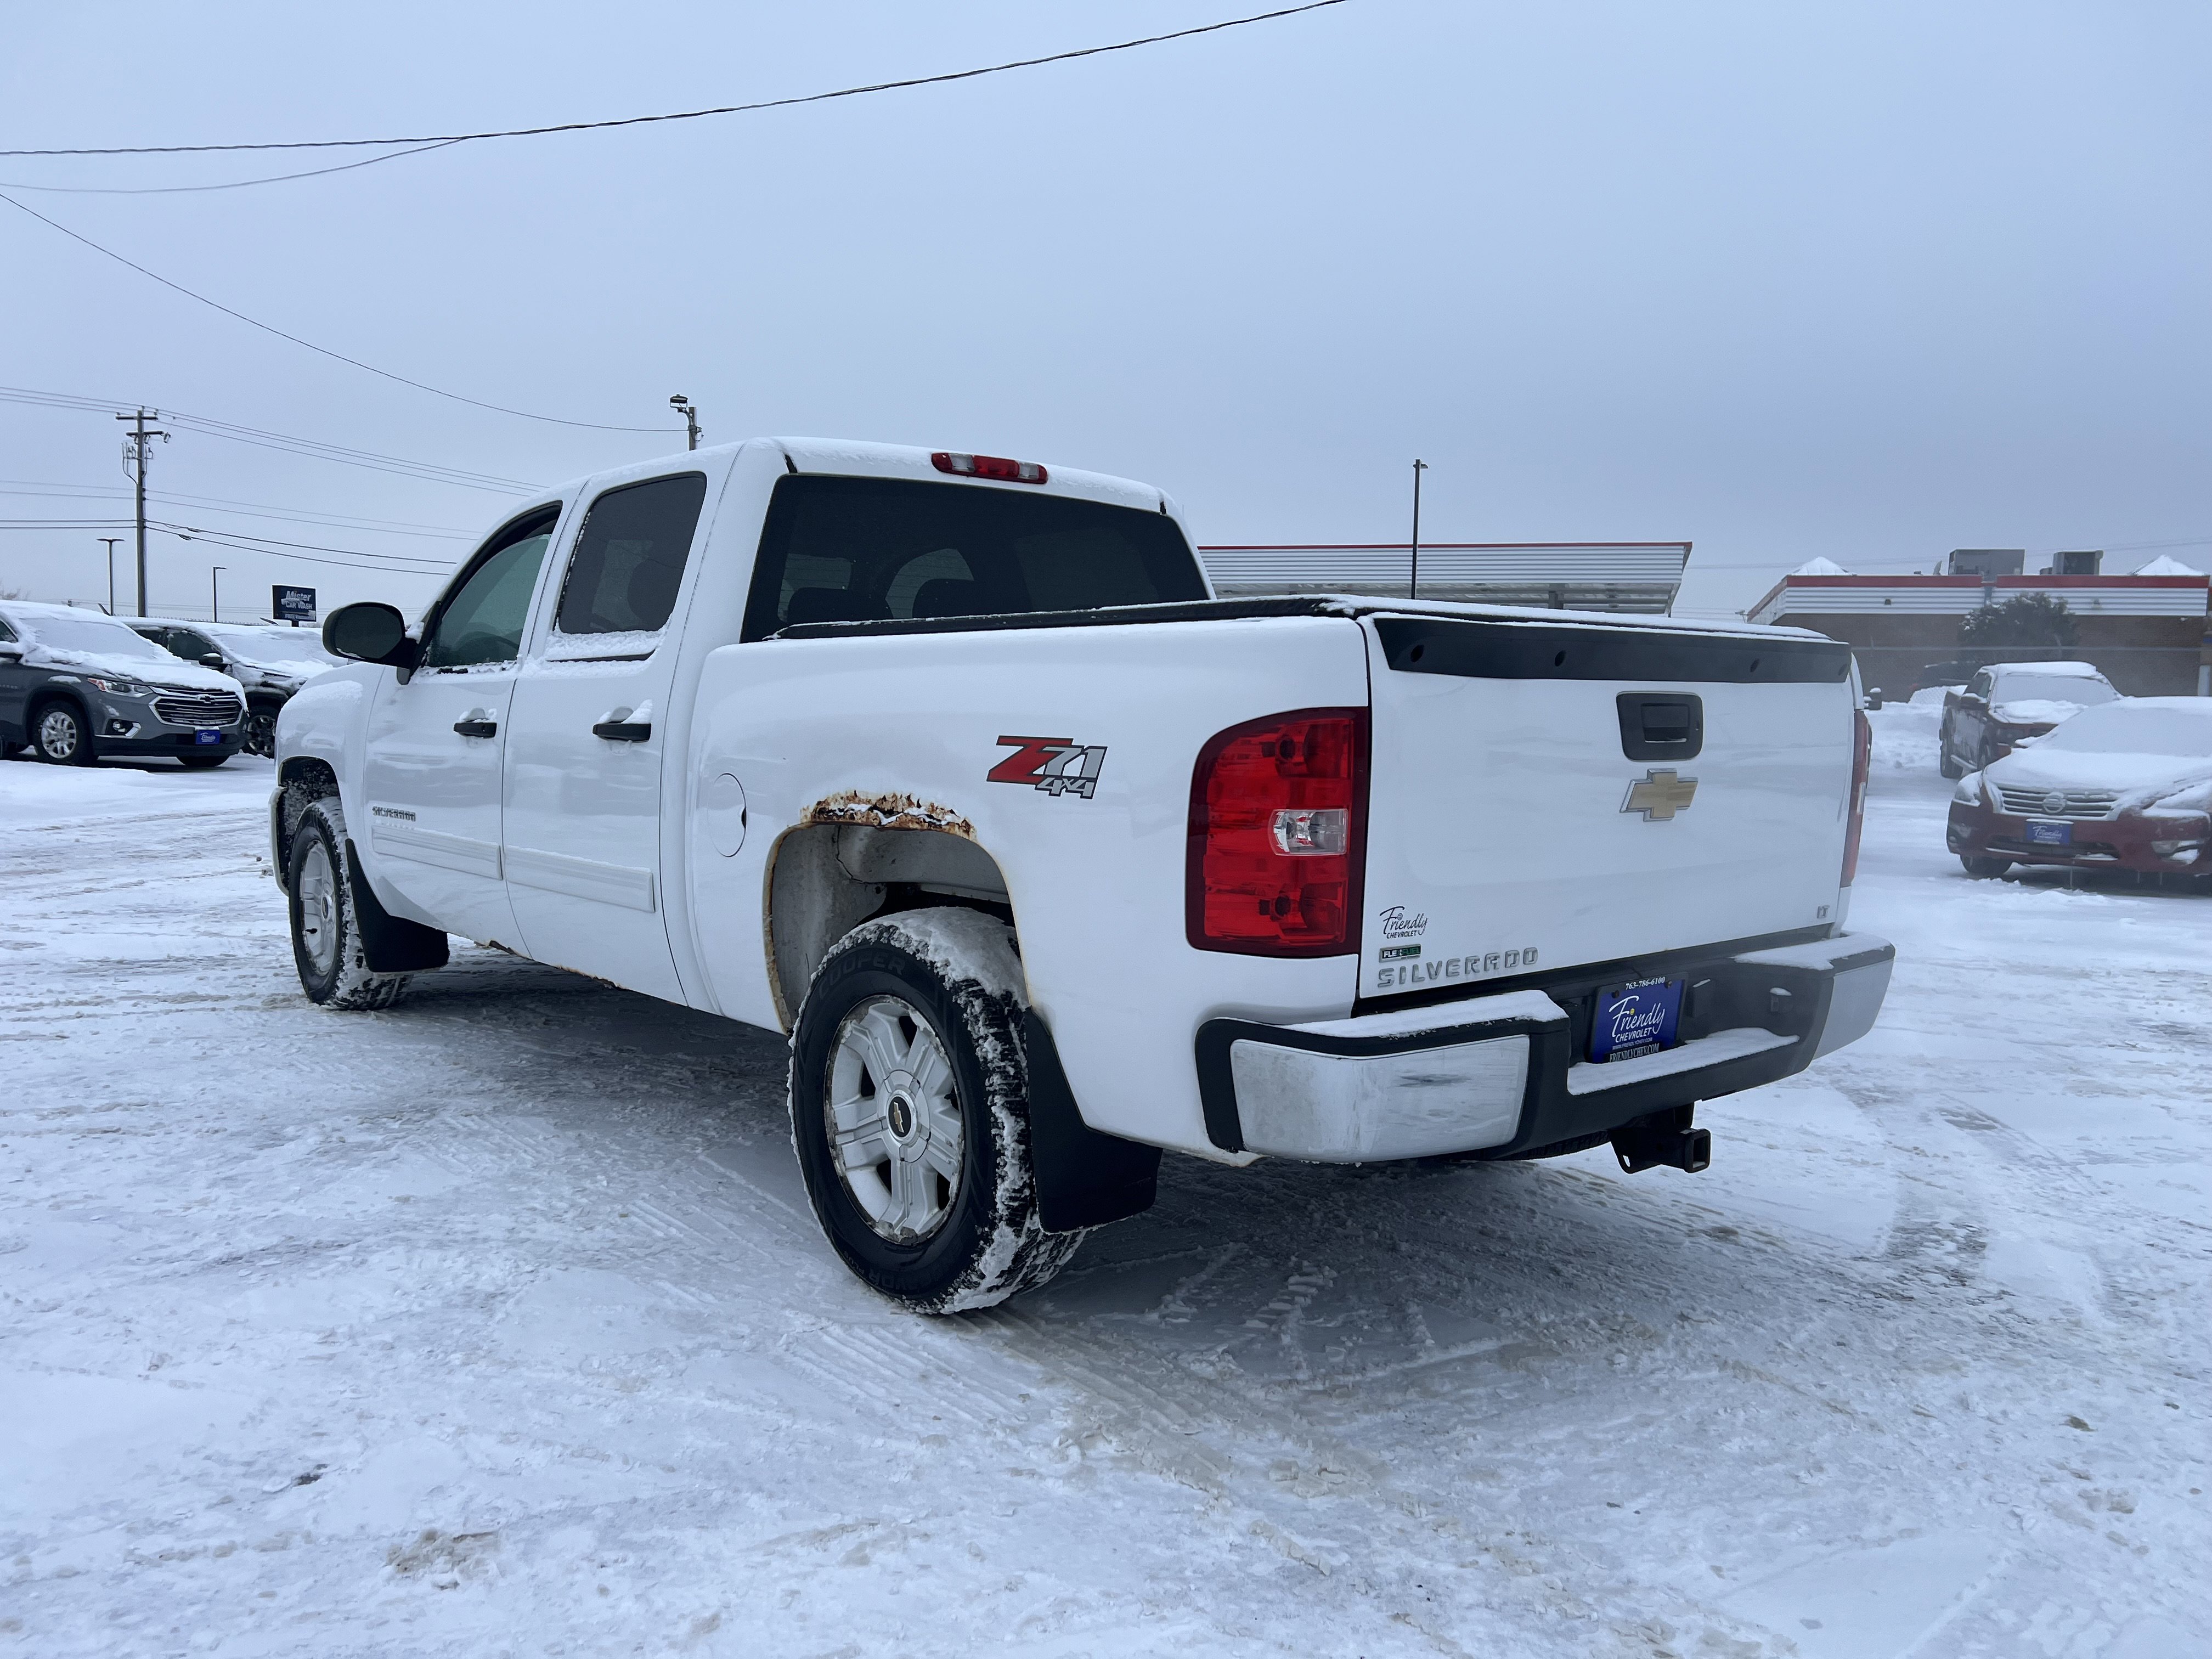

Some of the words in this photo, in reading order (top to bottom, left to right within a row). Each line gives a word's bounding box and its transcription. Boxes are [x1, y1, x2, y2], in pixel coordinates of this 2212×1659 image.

[286, 590, 312, 601] Mister
[986, 735, 1108, 785] Z71
[1379, 906, 1428, 935] Friendly
[1386, 930, 1417, 939] CHEVROLET
[1378, 947, 1538, 988] SILVERADO
[1626, 977, 1666, 990] 763-786-6100
[1609, 995, 1666, 1037] Friendly
[1615, 1027, 1652, 1043] CHEVROLET
[1609, 1043, 1660, 1063] FRIENDLYCHEV.COM
